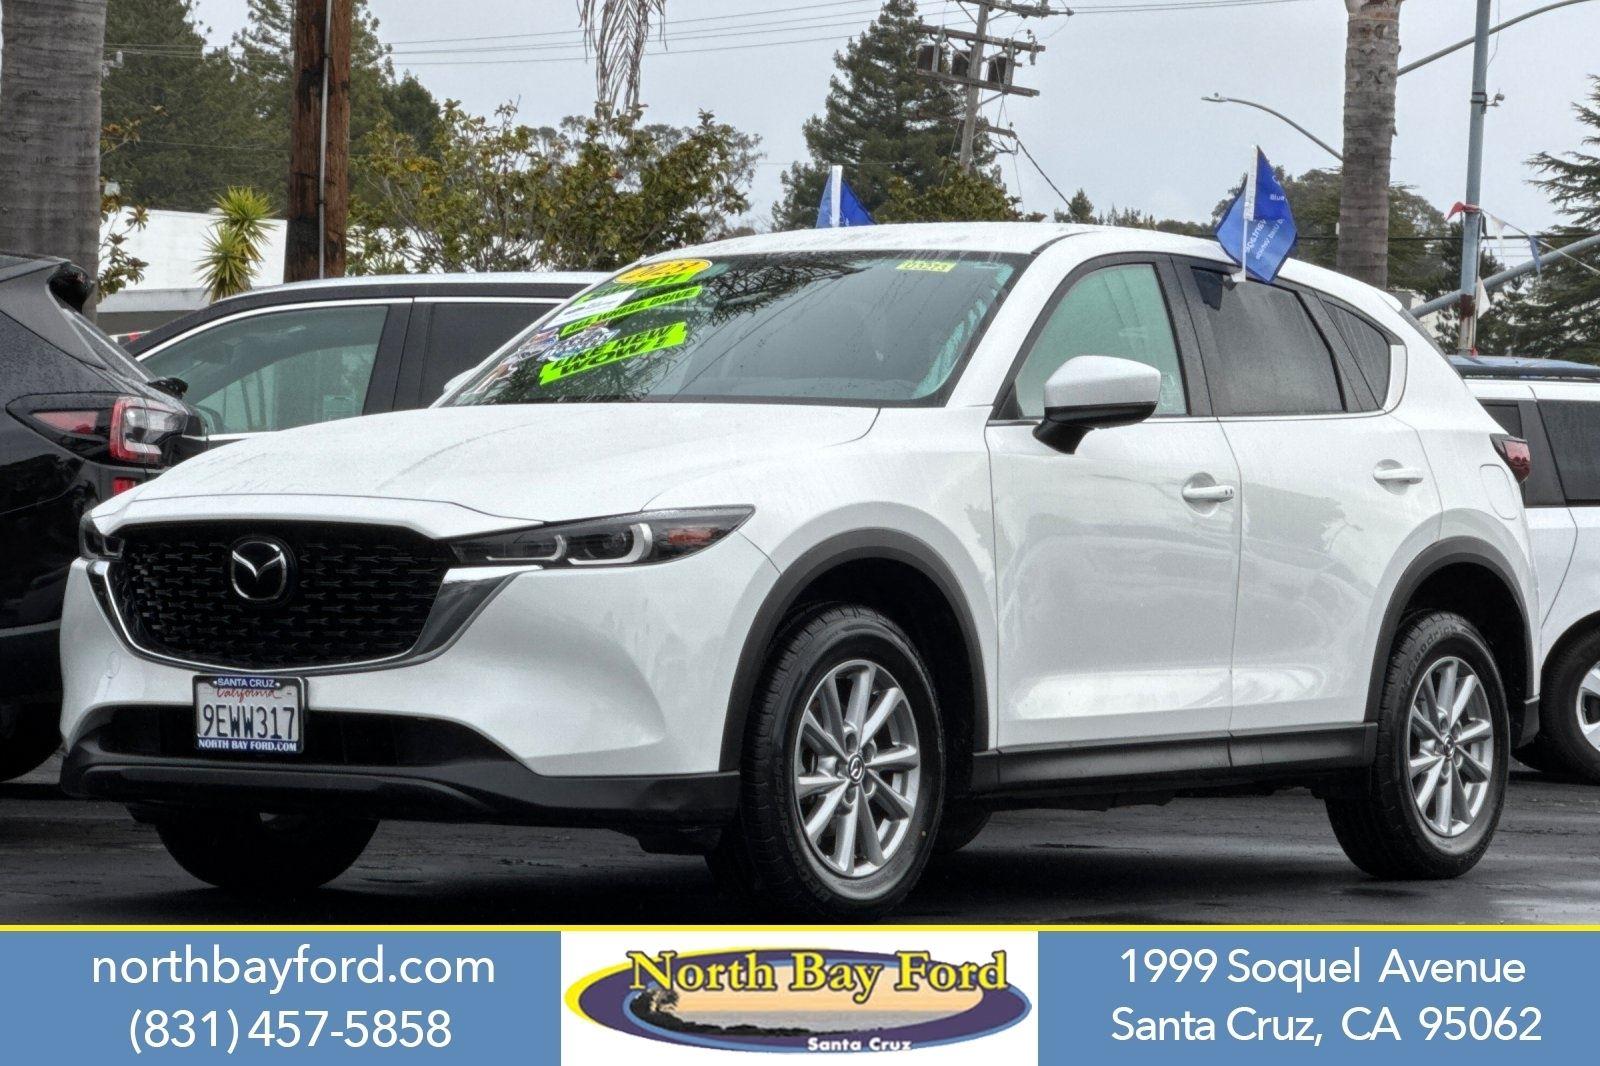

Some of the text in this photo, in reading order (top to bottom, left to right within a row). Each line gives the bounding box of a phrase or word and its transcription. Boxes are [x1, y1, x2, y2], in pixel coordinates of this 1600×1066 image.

[597, 302, 645, 320] WHEEL
[649, 289, 696, 306] DRIVE
[550, 345, 605, 370] LIKE
[612, 325, 675, 348] NEW
[217, 678, 276, 688] SANTA CRUZ
[217, 687, 282, 703] California
[203, 704, 295, 740] 9EWW317
[198, 739, 297, 752] NORTH BAY FORD.COM
